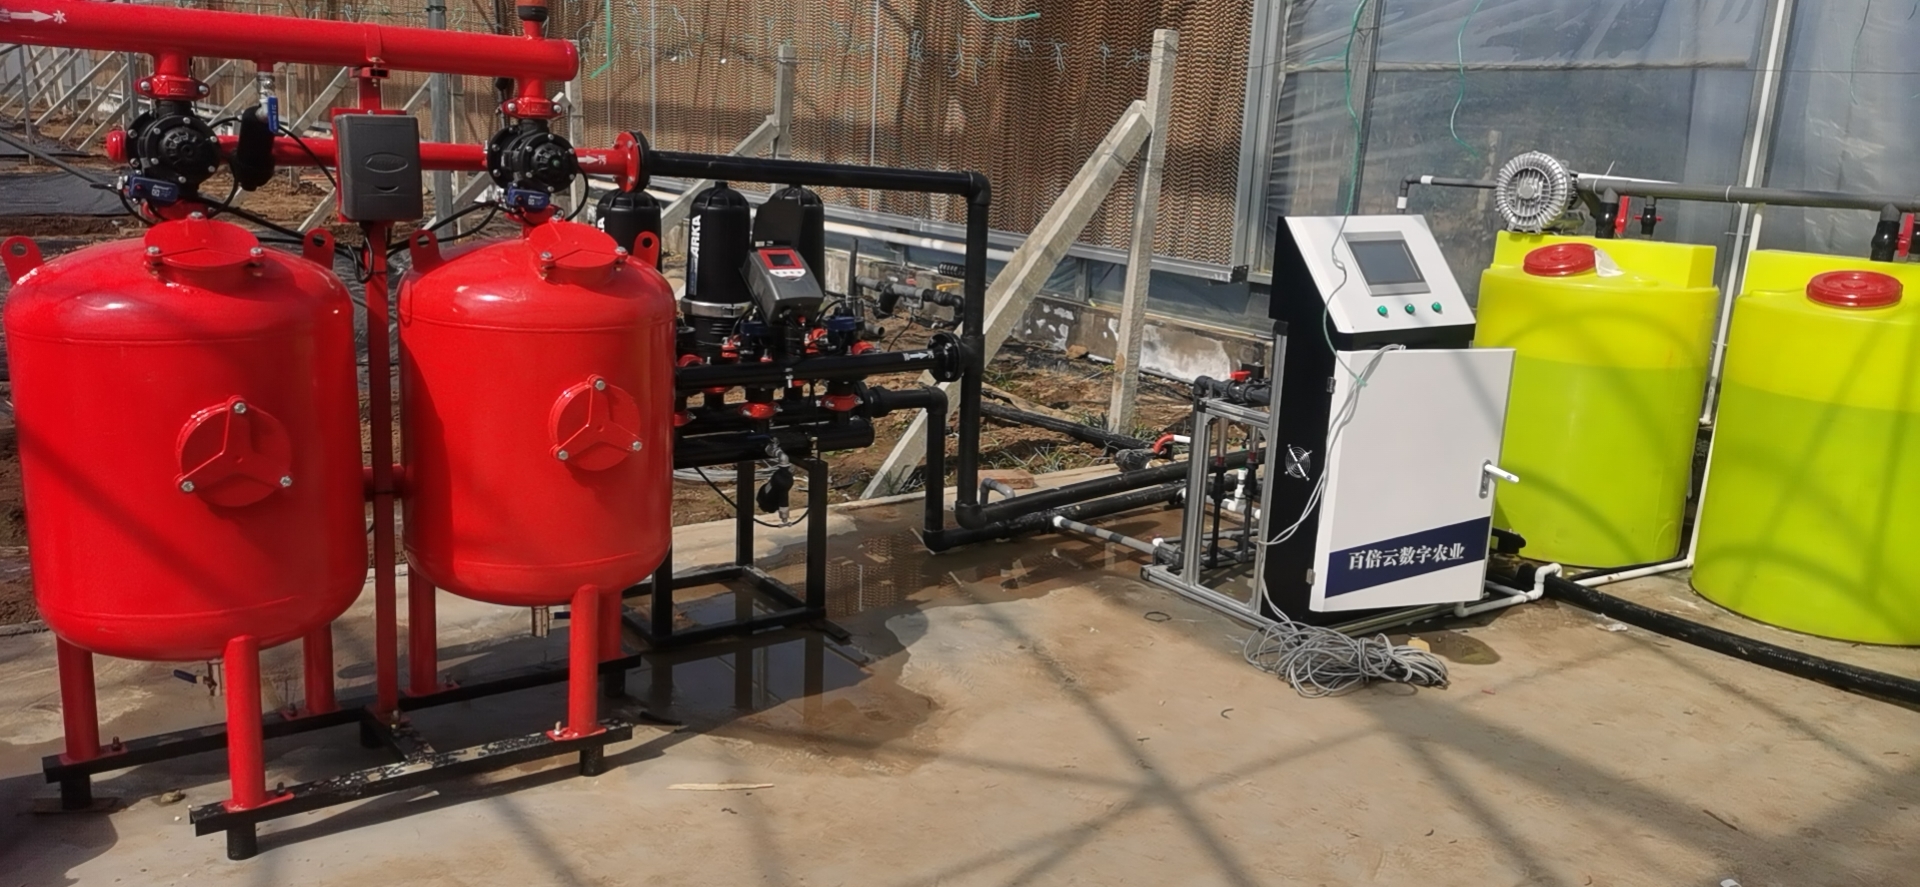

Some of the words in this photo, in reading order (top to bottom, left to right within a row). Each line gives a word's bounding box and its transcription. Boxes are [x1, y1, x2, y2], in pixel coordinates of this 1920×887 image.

[1349, 542, 1466, 570] 百倍云数字农业
